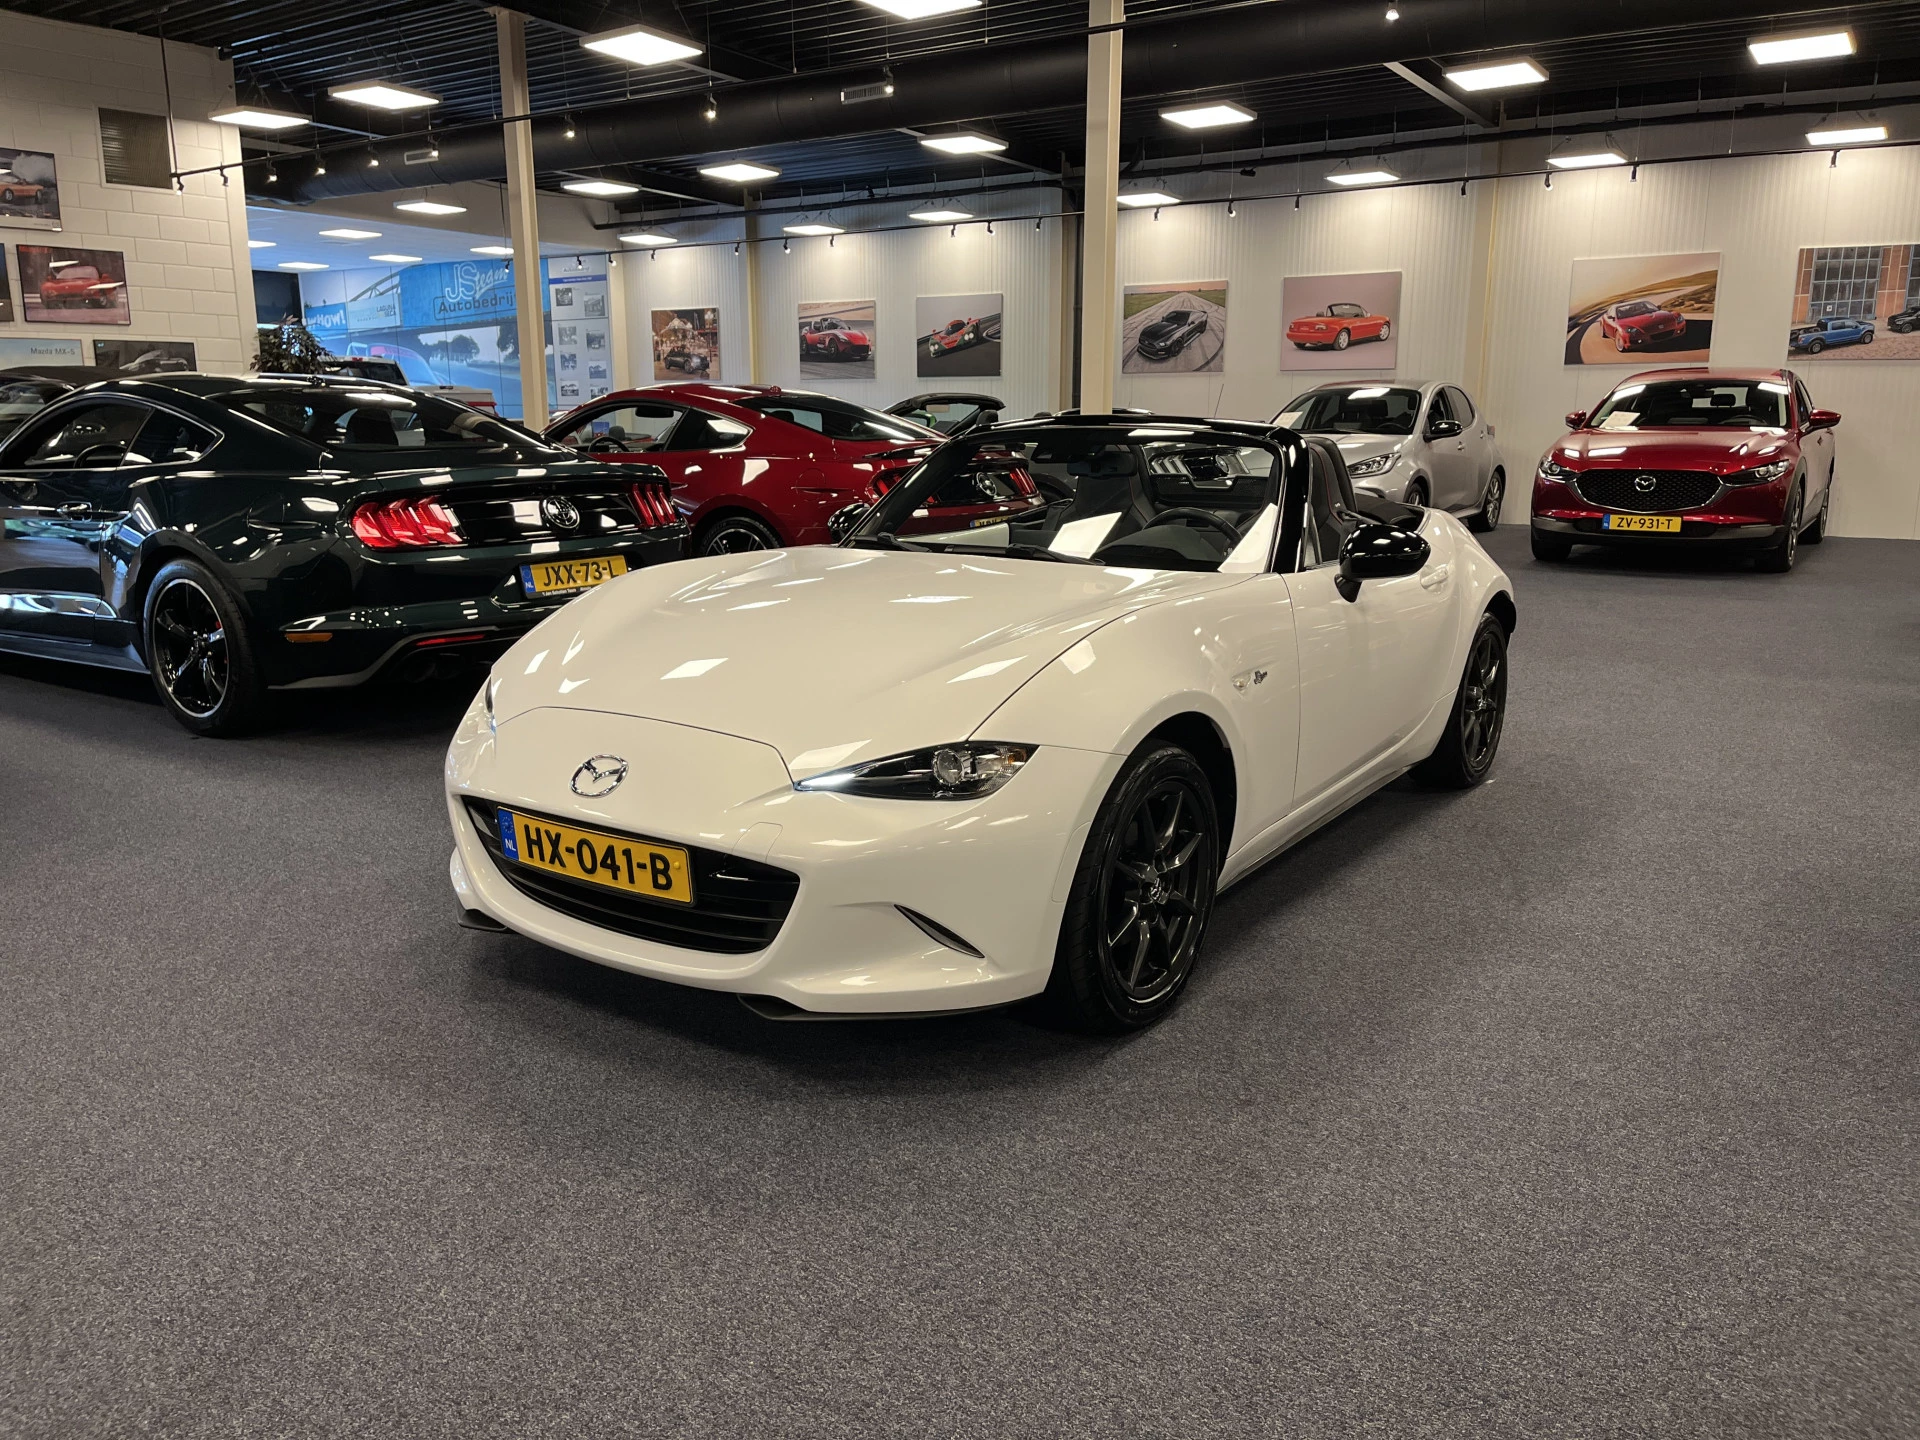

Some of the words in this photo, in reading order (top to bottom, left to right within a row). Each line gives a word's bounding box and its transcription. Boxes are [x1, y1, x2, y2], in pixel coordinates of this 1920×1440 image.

[438, 292, 516, 314] Autobedrij
[30, 347, 53, 355] Mazda
[1616, 517, 1673, 530] ZV-931-T
[543, 560, 620, 587] JXX-73-L
[524, 581, 534, 589] NL
[505, 838, 516, 852] NL
[523, 823, 673, 891] HX-041-B
